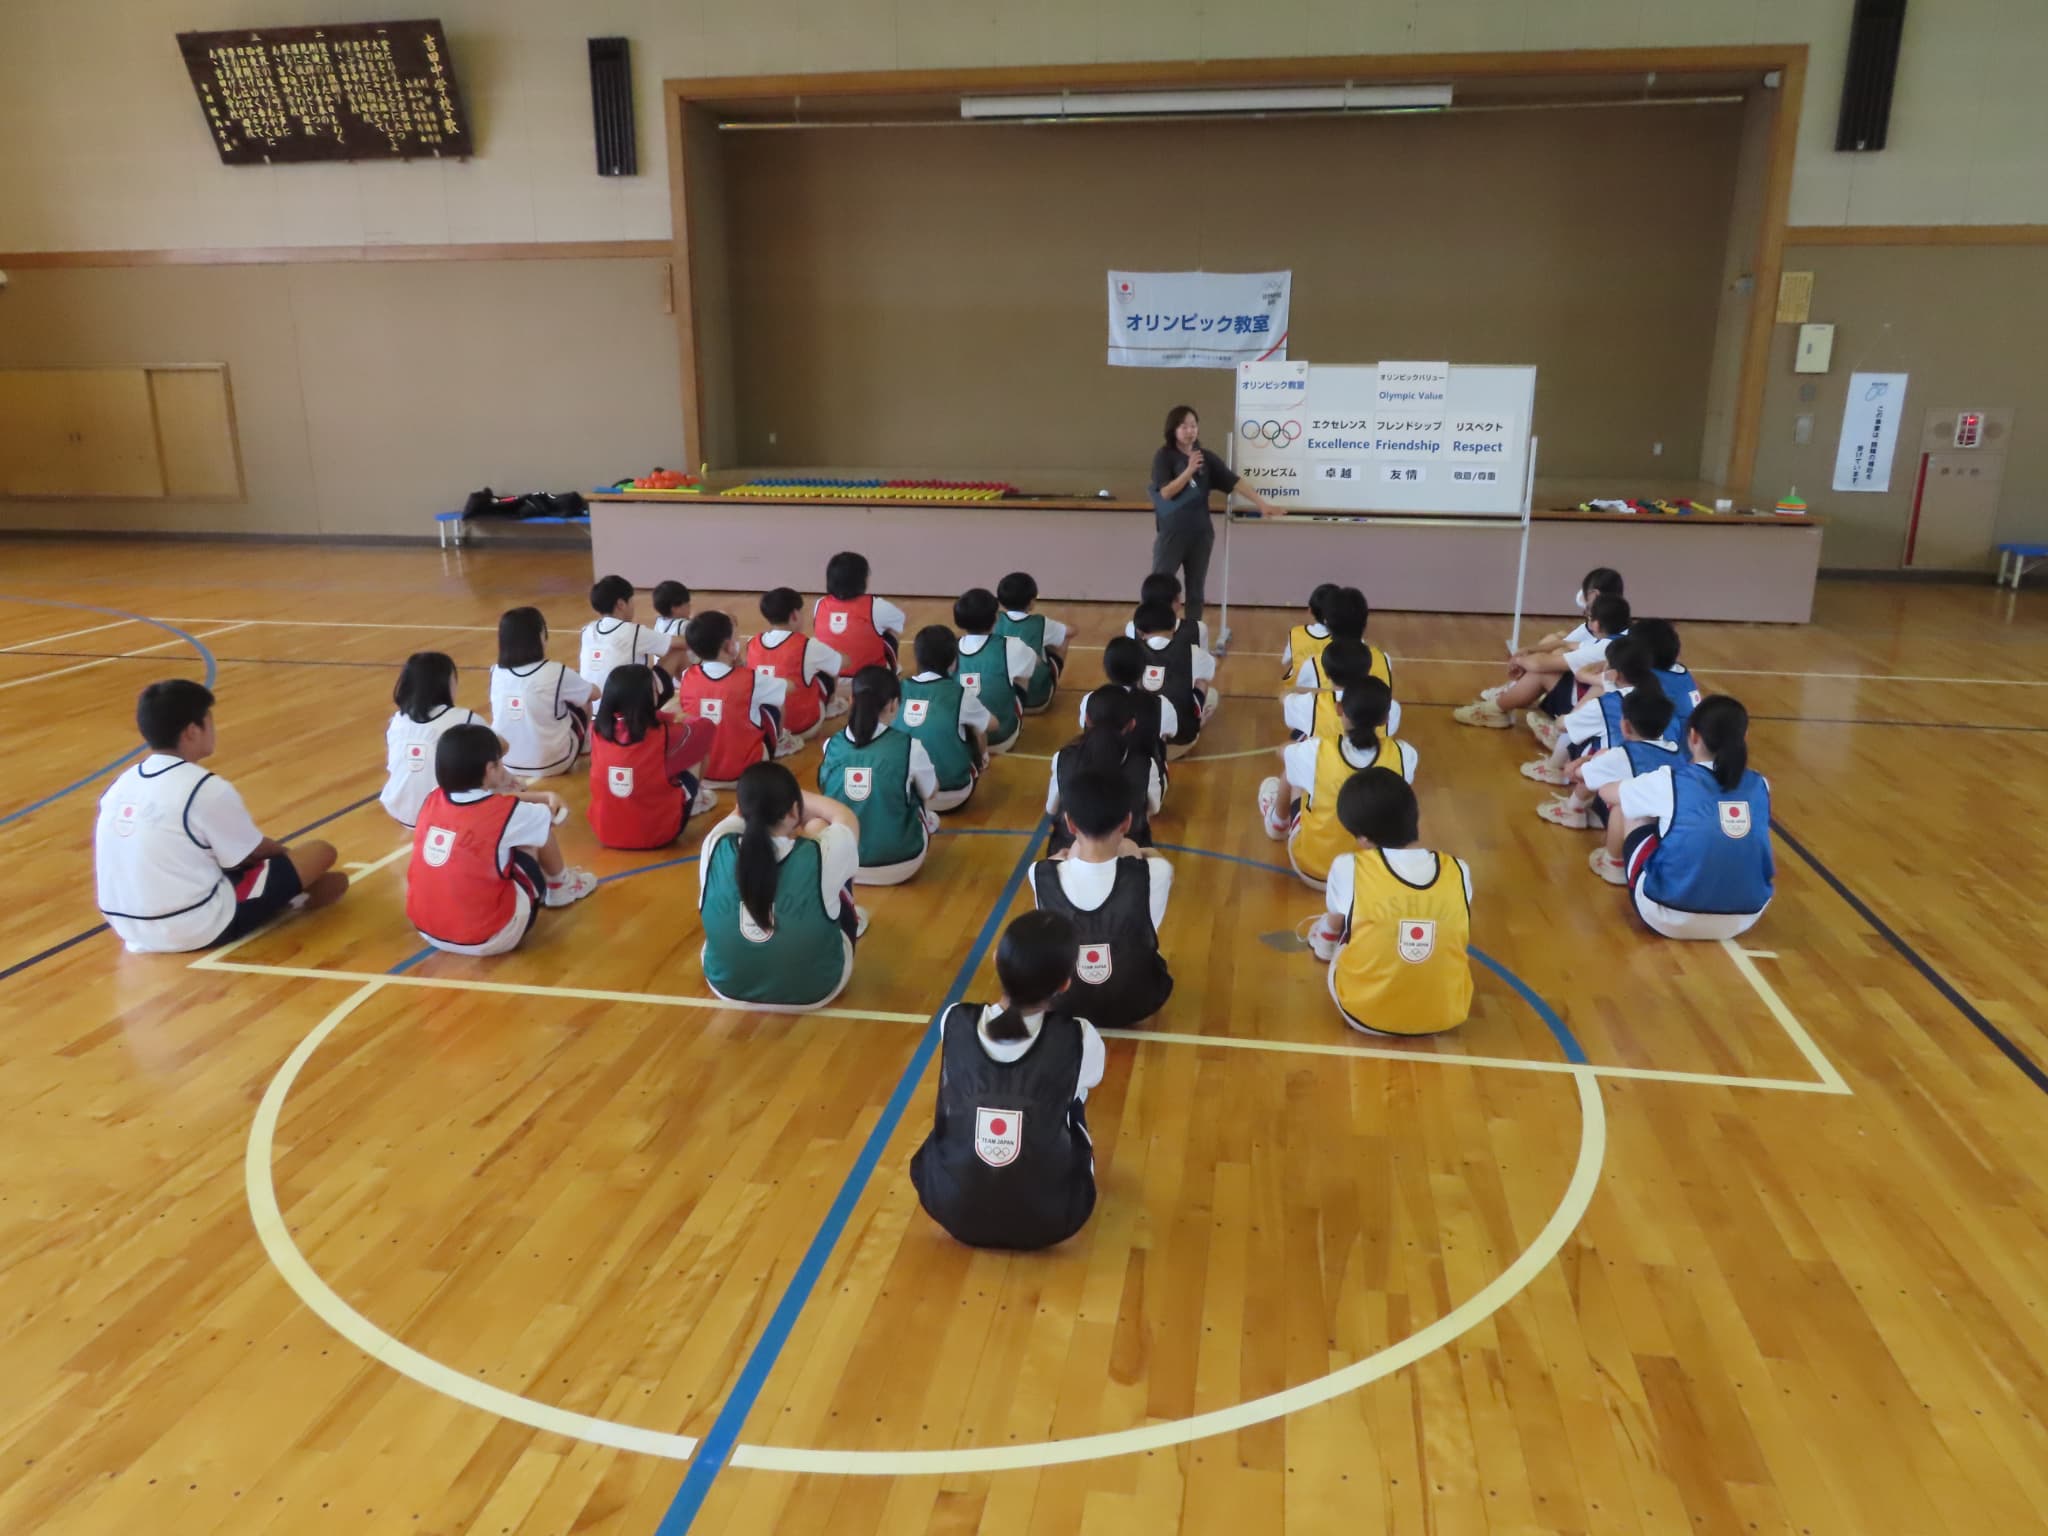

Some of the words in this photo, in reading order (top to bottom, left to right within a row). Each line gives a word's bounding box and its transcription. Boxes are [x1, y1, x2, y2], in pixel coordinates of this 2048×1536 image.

[1126, 313, 1270, 334] オリンピック教室
[1241, 380, 1305, 390] オリンピック教室
[1379, 391, 1416, 402] Olympic
[1418, 391, 1444, 400] Value
[1312, 420, 1367, 430] エクセレンス
[1376, 421, 1442, 431] フレンドシップ
[1456, 422, 1504, 432] リスペクト
[1308, 438, 1370, 449] Excellence
[1375, 439, 1440, 453] Friendship
[1453, 440, 1503, 454] Respect
[1243, 467, 1297, 477] オリンピズム
[1390, 469, 1418, 481] 友情
[1255, 485, 1300, 499] mpism
